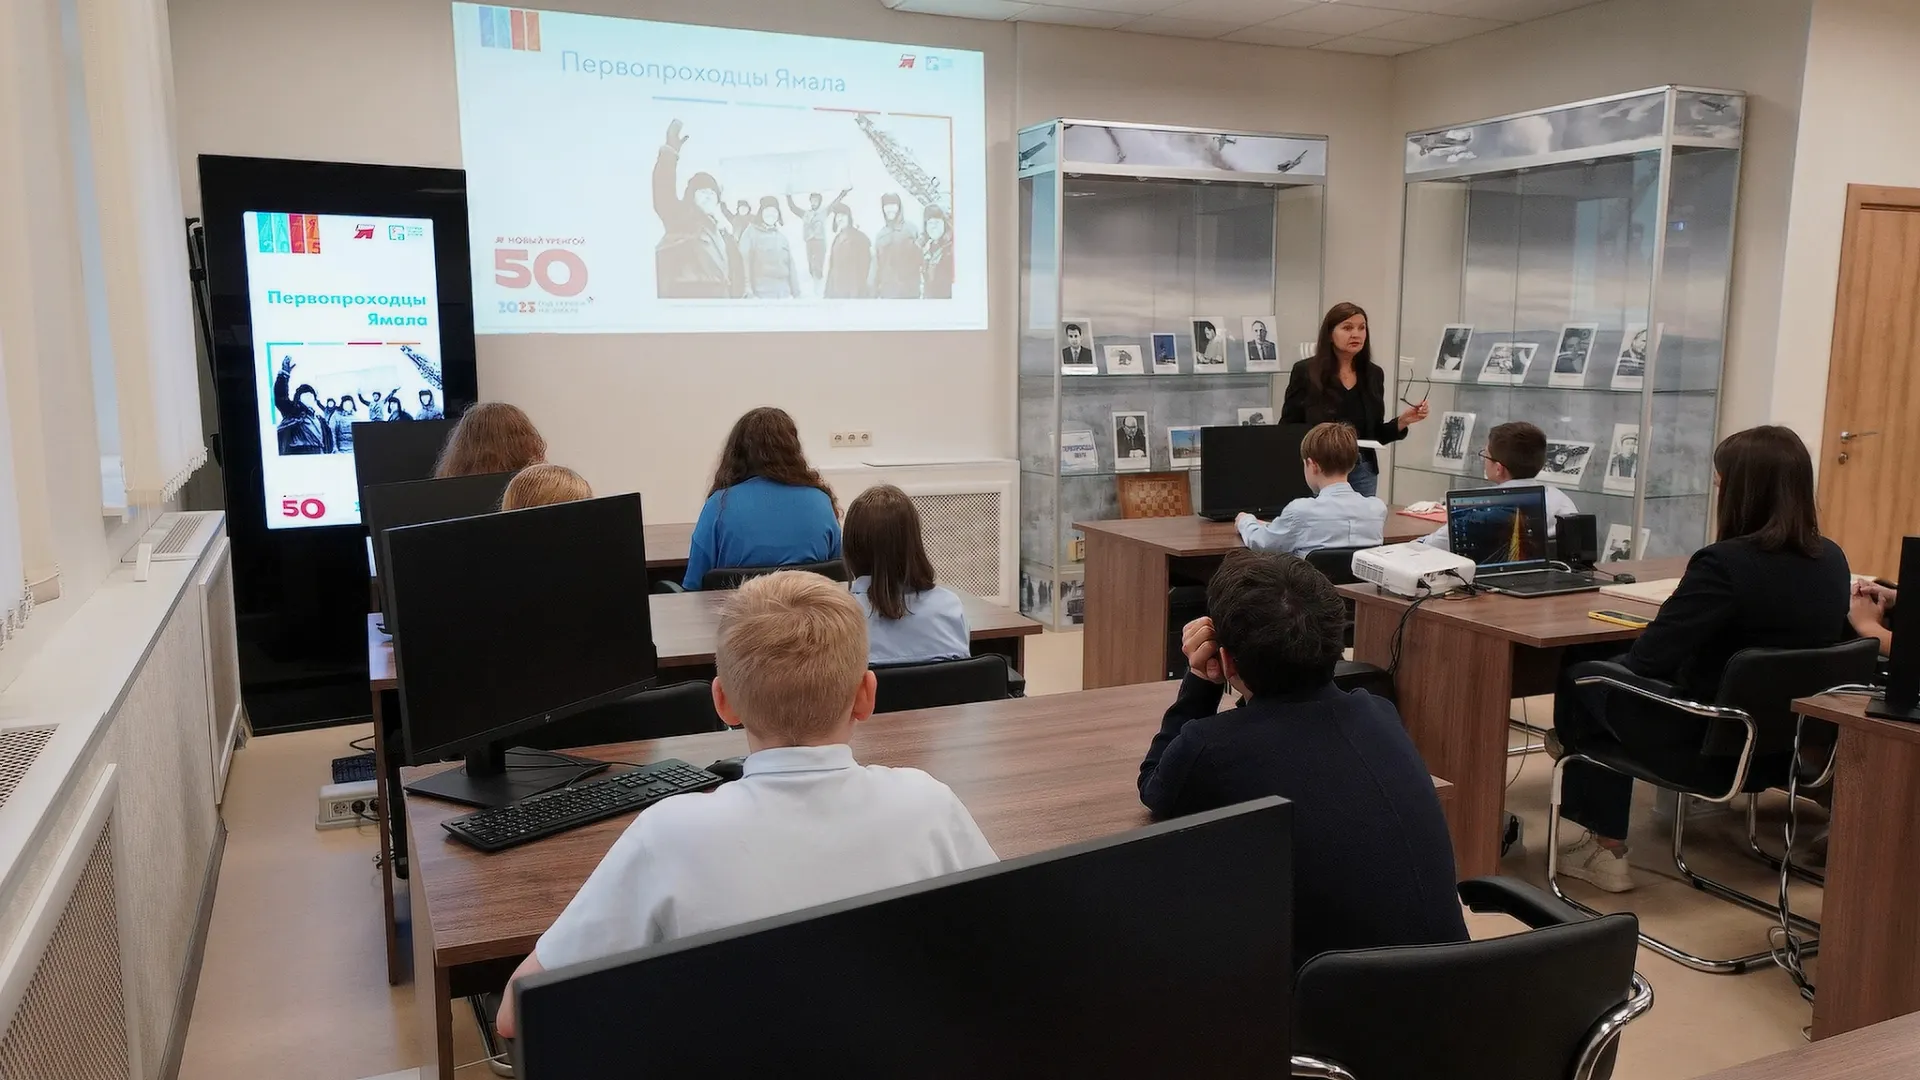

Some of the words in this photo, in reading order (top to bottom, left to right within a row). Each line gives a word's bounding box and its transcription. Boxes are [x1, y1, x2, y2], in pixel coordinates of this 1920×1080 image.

[562, 50, 768, 87] Первопроходцы
[776, 68, 846, 93] Ямала
[546, 236, 585, 246] УРЕНГОЙ
[494, 248, 588, 297] 50
[267, 290, 426, 308] Первопроходцы
[368, 312, 428, 326] Ямала
[282, 498, 326, 519] 50
